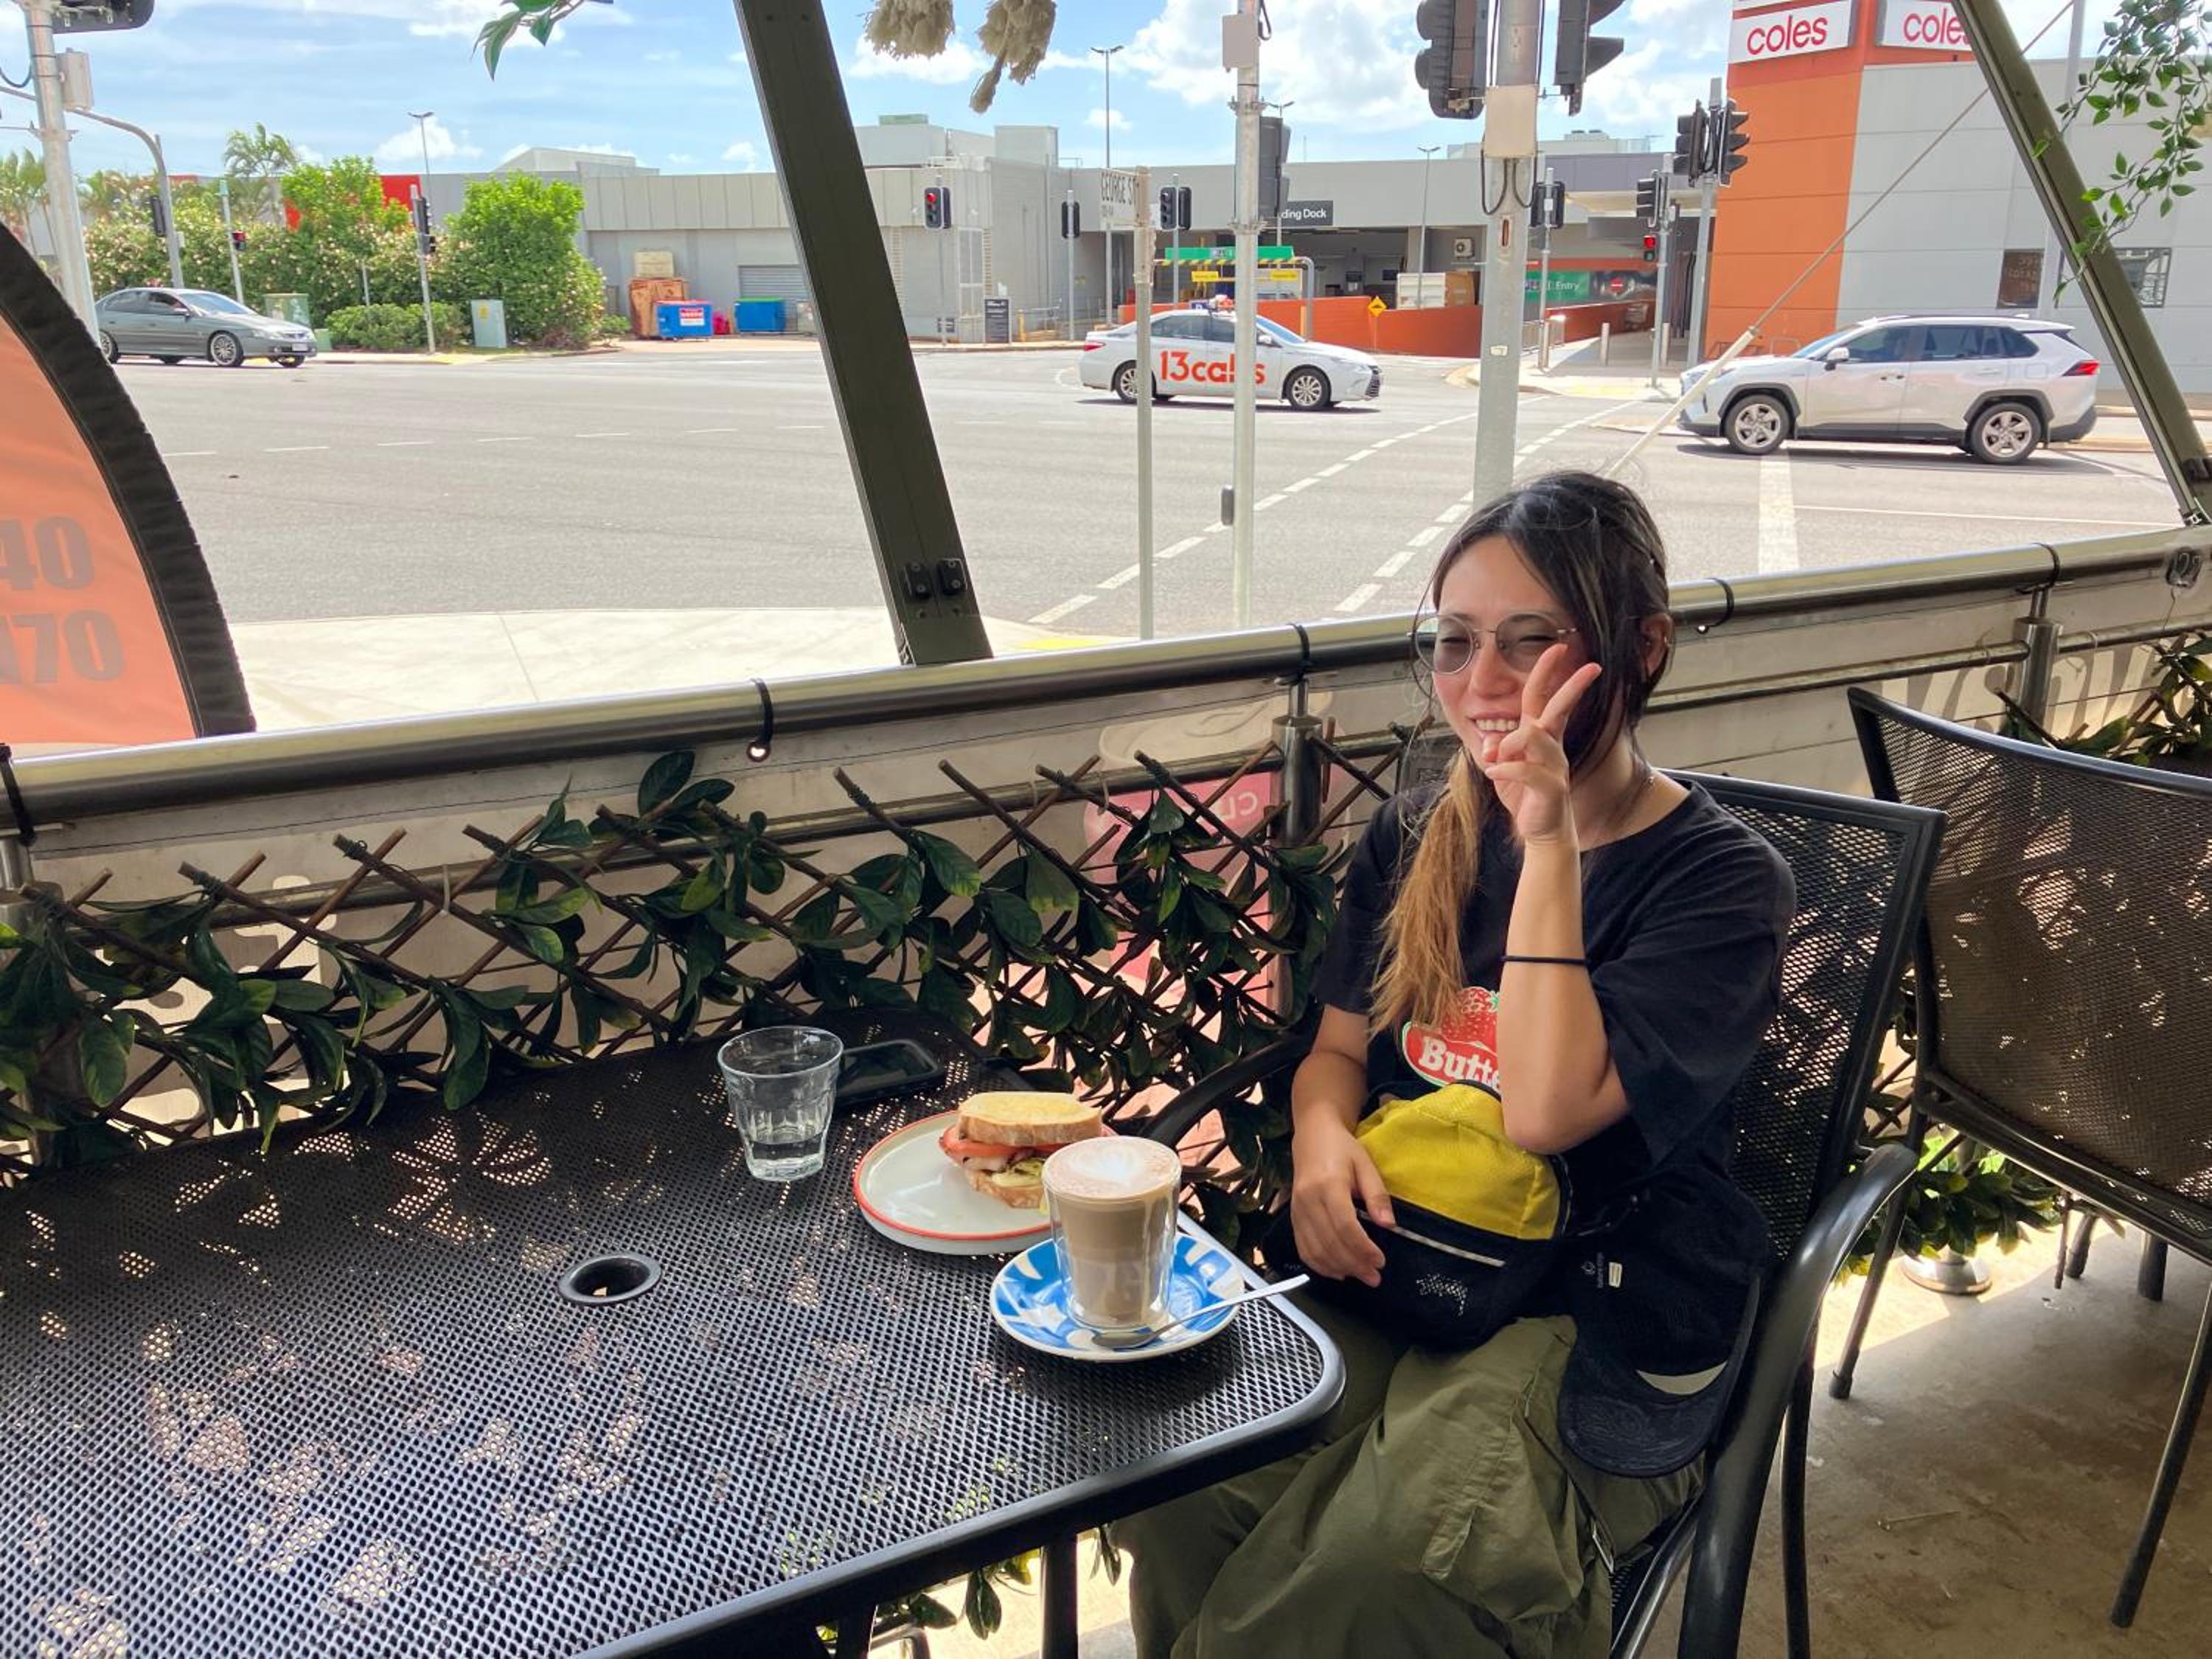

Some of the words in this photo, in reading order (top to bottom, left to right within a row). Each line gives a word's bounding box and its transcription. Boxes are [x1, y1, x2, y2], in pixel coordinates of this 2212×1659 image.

[1747, 15, 1828, 55] coles
[1904, 8, 1971, 44] cole
[1101, 171, 1126, 203] GEORGE
[1281, 209, 1301, 220] ding
[1303, 208, 1326, 218] Dock
[1556, 282, 1580, 291] Entry
[1161, 351, 1265, 384] 13cas
